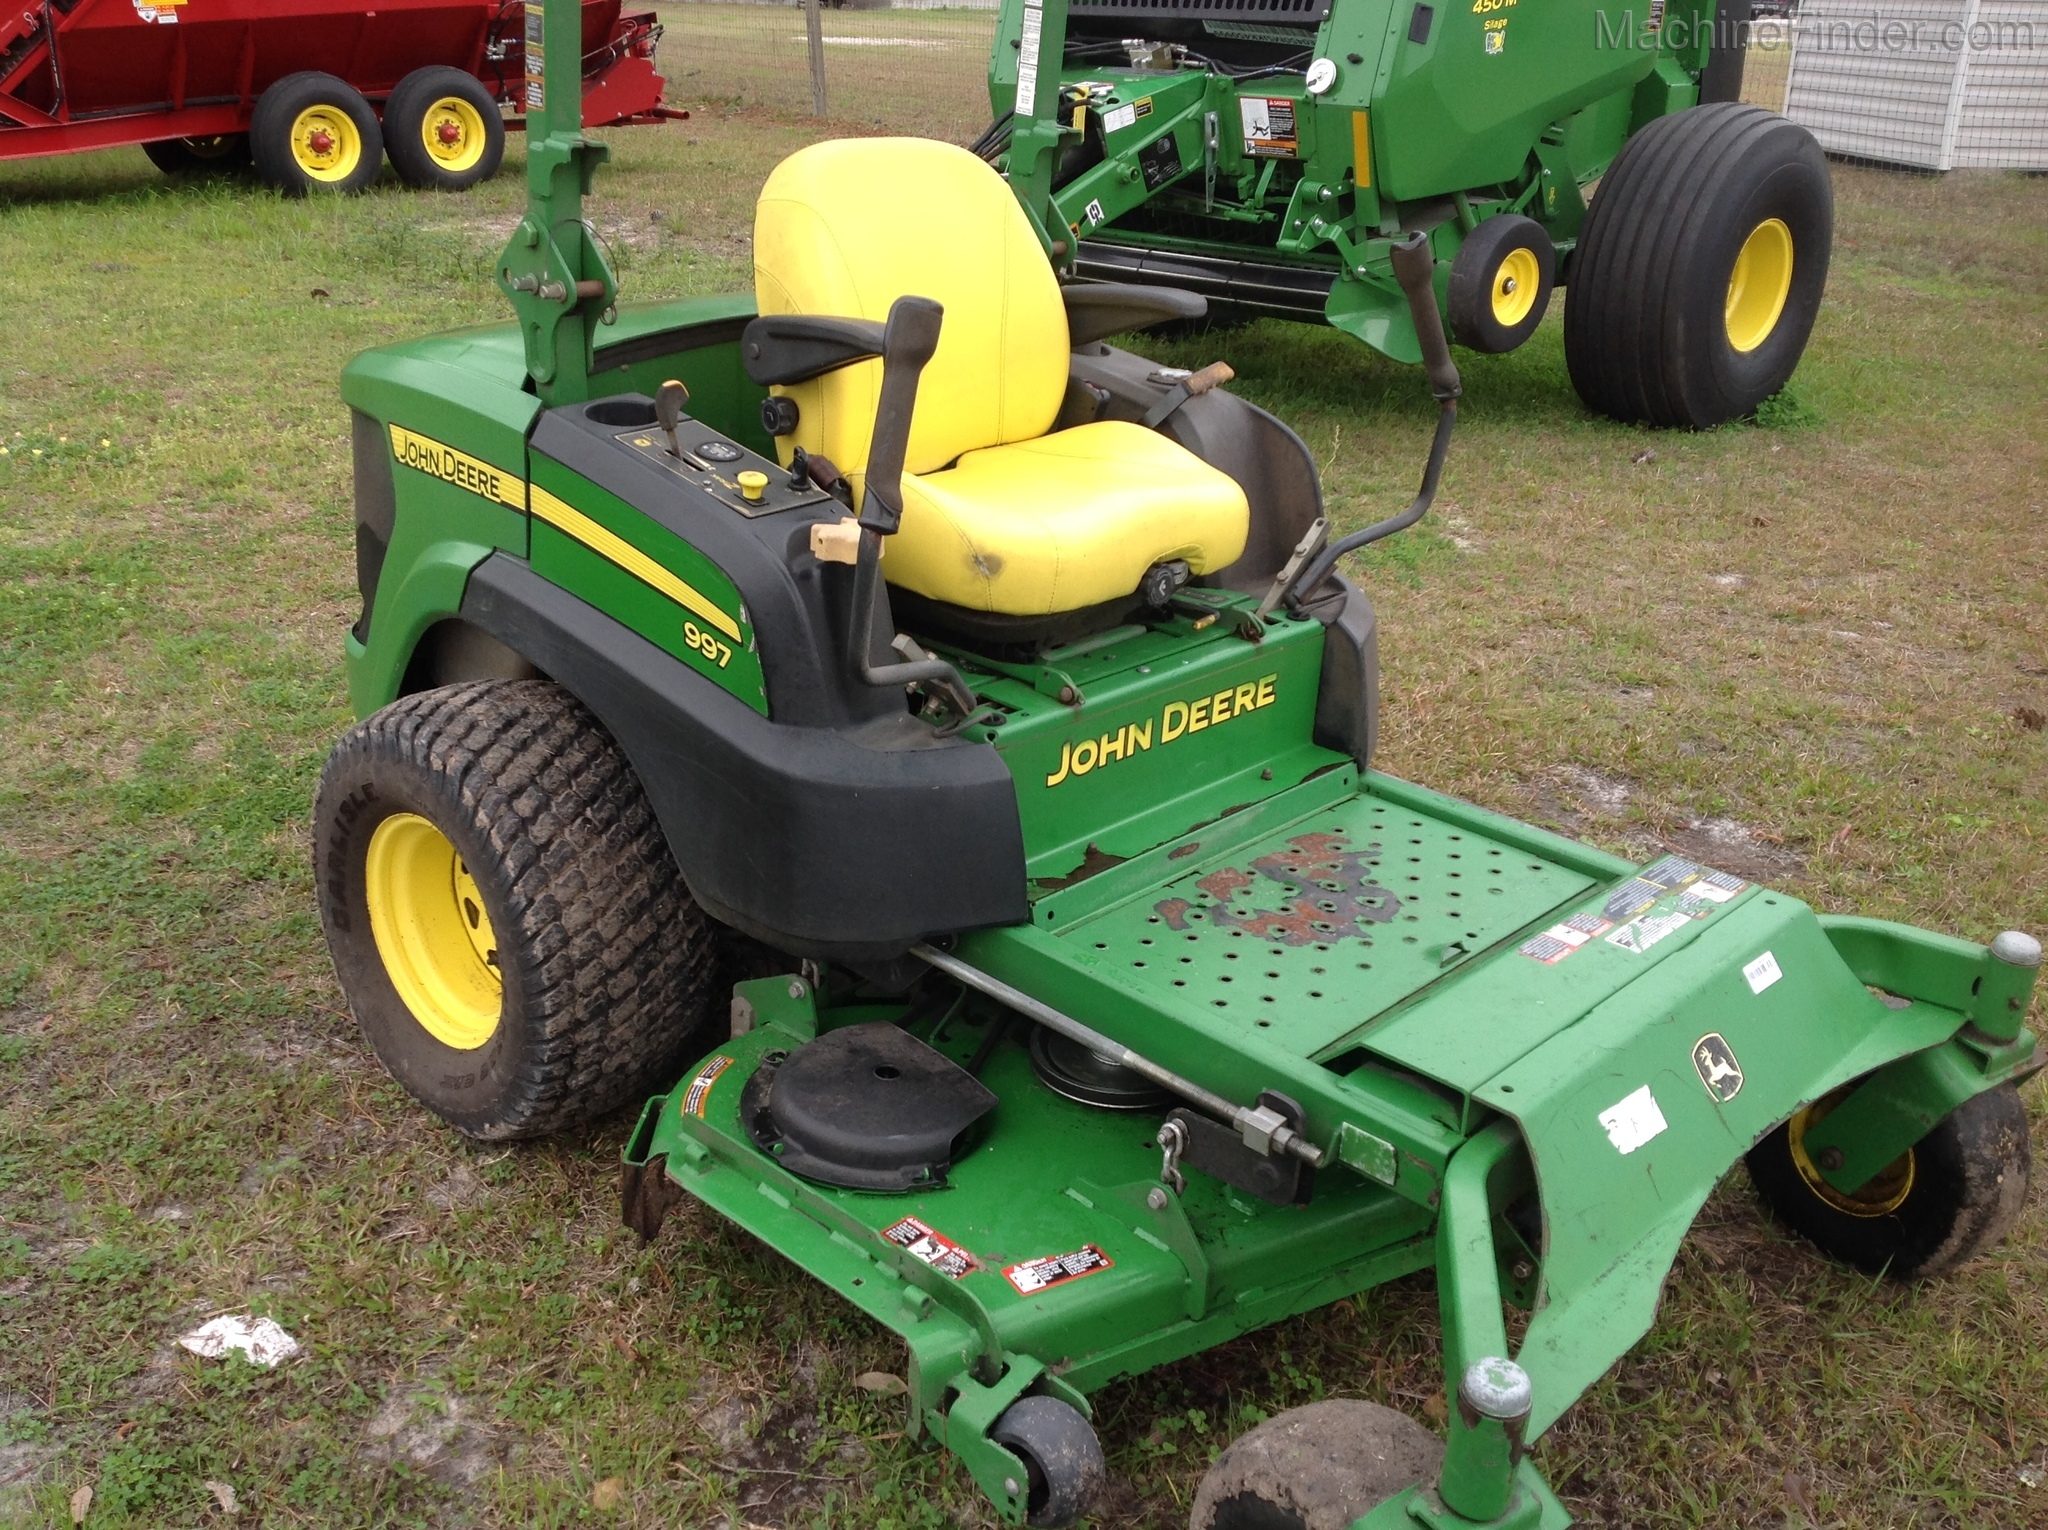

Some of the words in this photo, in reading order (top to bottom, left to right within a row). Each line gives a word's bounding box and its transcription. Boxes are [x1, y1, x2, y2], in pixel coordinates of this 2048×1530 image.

[1472, 0, 1503, 14] 450
[401, 435, 440, 473] JOHN
[444, 449, 501, 500] DEERE
[684, 621, 732, 668] 997
[1046, 717, 1154, 788] JOHN
[1160, 673, 1279, 745] DEERE
